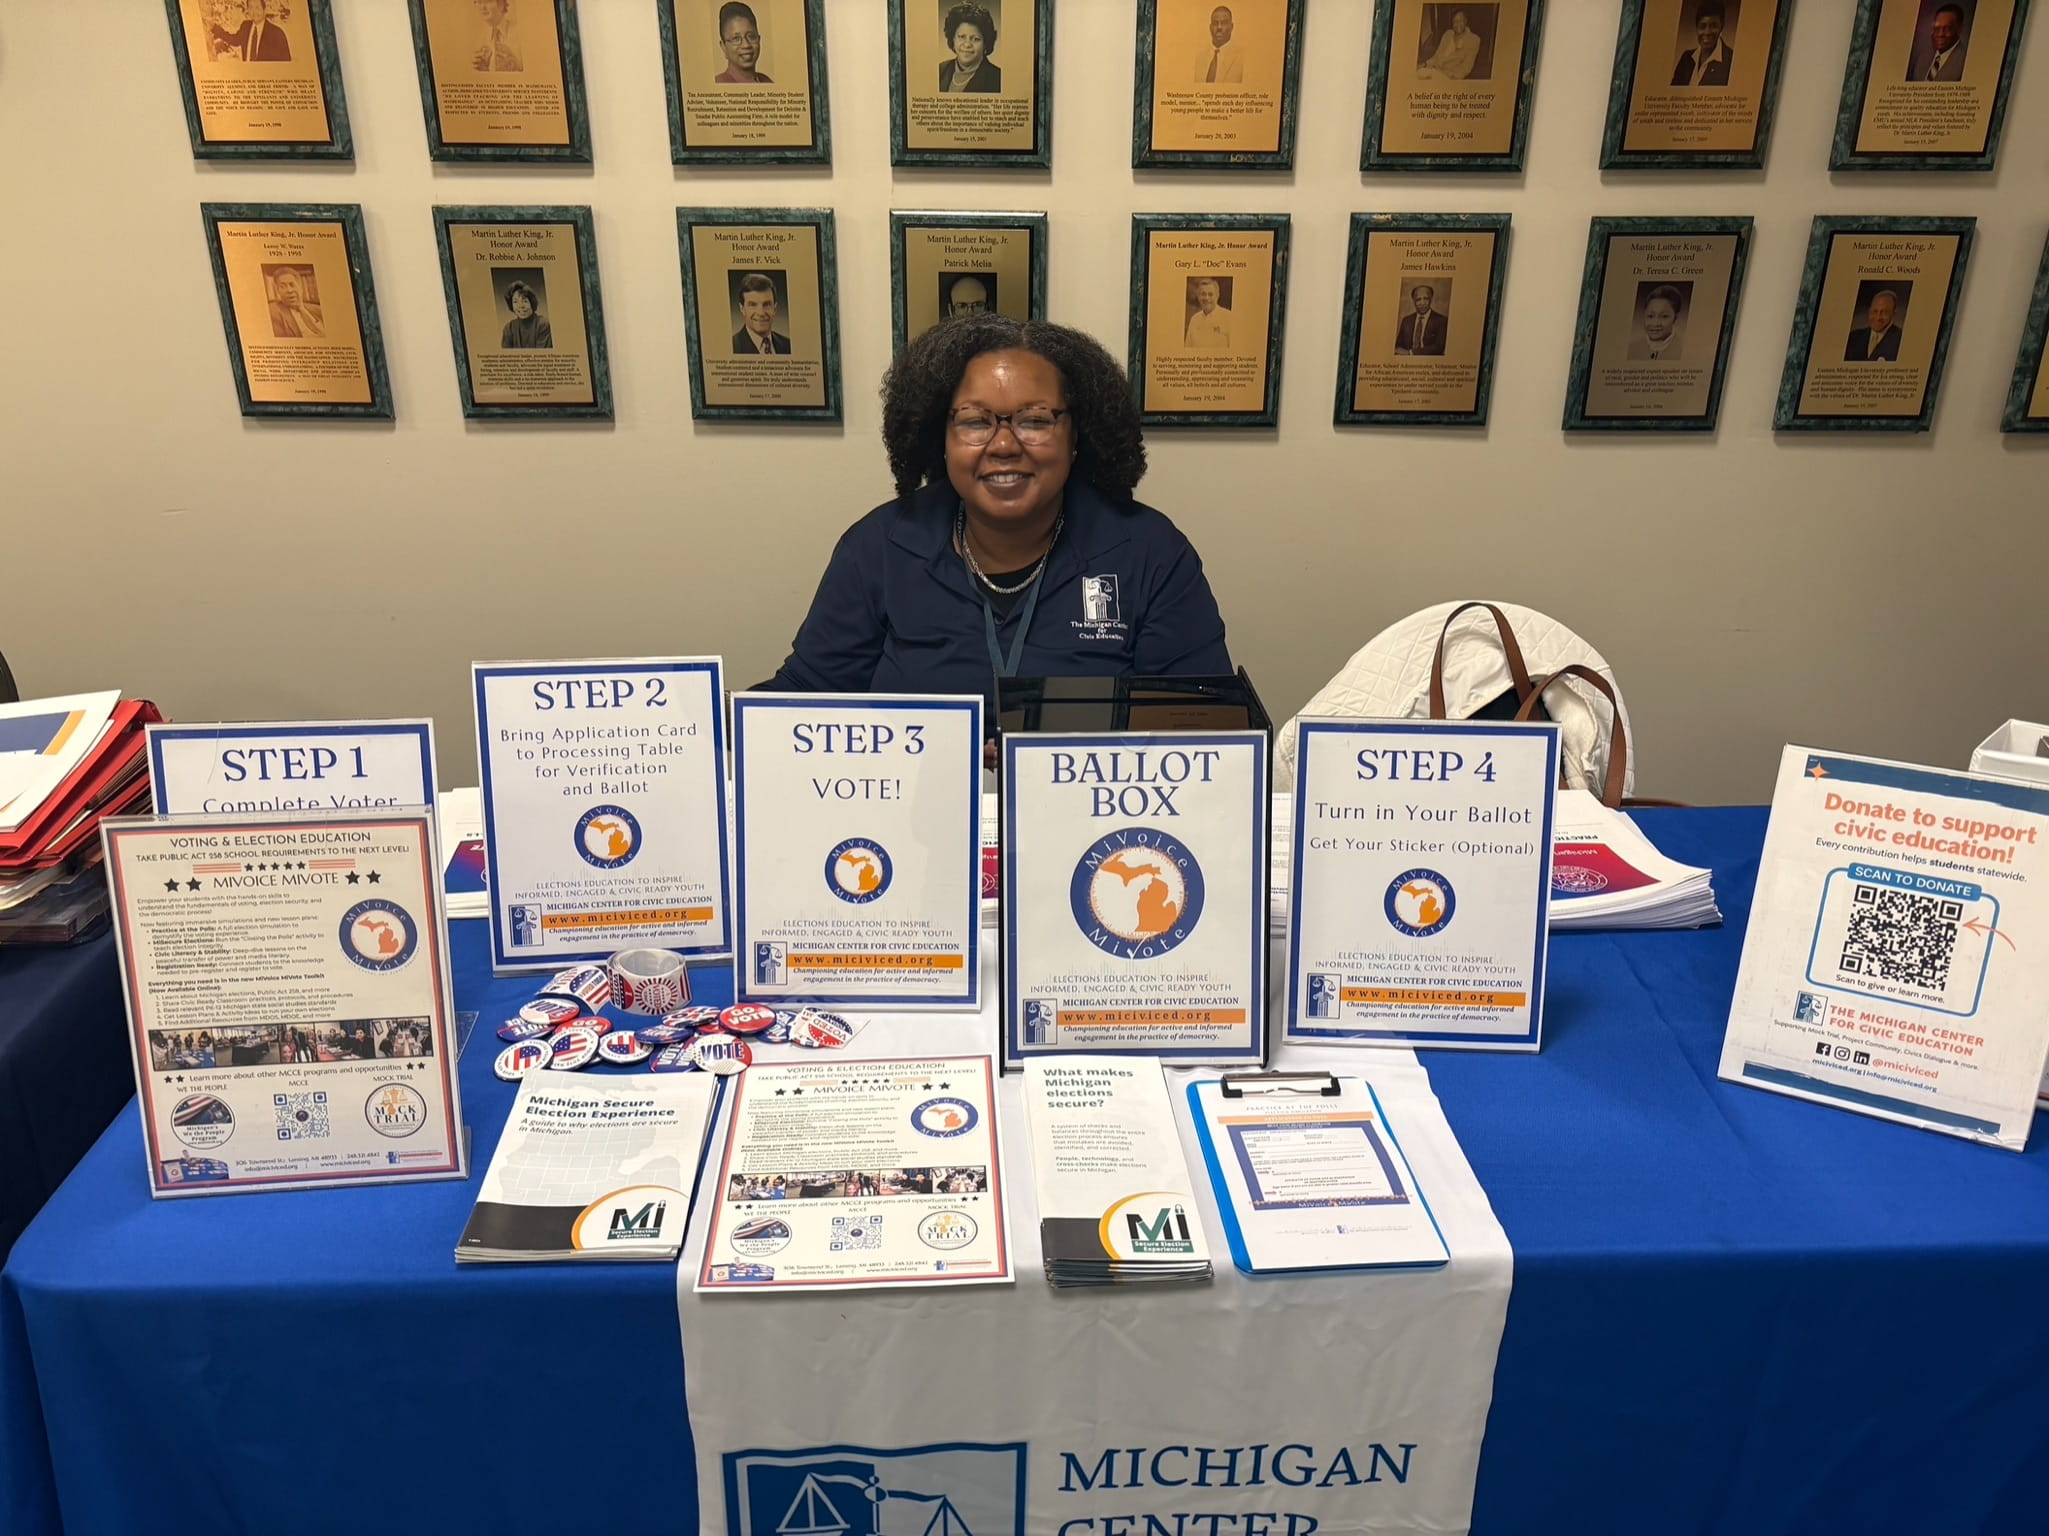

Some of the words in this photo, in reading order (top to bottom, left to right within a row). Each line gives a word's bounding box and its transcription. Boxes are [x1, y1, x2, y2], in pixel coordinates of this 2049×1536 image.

[471, 228, 496, 237] Martin
[497, 229, 521, 238] Luther
[523, 229, 543, 239] King,
[740, 232, 763, 241] Luther
[765, 232, 785, 242] King,
[926, 234, 951, 243] Martin
[953, 234, 976, 243] Luther
[979, 235, 998, 245] King,
[732, 242, 754, 251] Honor
[756, 243, 779, 251] Award
[944, 244, 966, 253] Honor
[968, 245, 992, 254] Award
[1416, 239, 1440, 248] Luther
[1442, 239, 1461, 249] King,
[473, 252, 487, 261] Dr.
[488, 252, 514, 261] Robbie
[764, 255, 781, 264] Vick
[944, 258, 968, 267] Patrick
[971, 259, 992, 268] Melia
[1175, 260, 1191, 269] Gary
[1400, 262, 1422, 270] James
[1424, 262, 1455, 270] Hawkins
[533, 679, 633, 710] STEP
[645, 678, 666, 706] 2
[501, 729, 543, 744] Bring
[552, 725, 648, 743] Application
[657, 723, 696, 736] Card
[793, 723, 893, 753] STEP
[905, 725, 924, 754] 3
[517, 748, 533, 759] to
[542, 745, 629, 759] Processing
[637, 742, 682, 755] Table
[222, 747, 336, 781] STEP
[349, 746, 367, 777] 1
[535, 765, 559, 778] for
[566, 762, 666, 776] Verification
[1051, 750, 1219, 783] BALLOT
[1357, 749, 1462, 781] STEP
[1473, 751, 1496, 782] 4
[563, 782, 592, 795] and
[601, 780, 648, 794] Ballot
[812, 778, 899, 799] VOTE!
[203, 796, 320, 814] Complete
[330, 795, 398, 808] Voter
[1090, 786, 1179, 816] BOX
[1315, 802, 1364, 819] Turn
[1376, 804, 1393, 819] in
[1405, 805, 1457, 821] Your
[1468, 806, 1531, 823] Ballot
[1824, 792, 1906, 821] Donate
[1913, 808, 1936, 826] to
[1942, 816, 2037, 844] support
[169, 836, 217, 847] VOTING
[222, 836, 230, 846] &
[234, 834, 296, 845] ELECTION
[300, 832, 370, 843] EDUCATION
[1310, 837, 1337, 849] Get
[1345, 838, 1382, 850] Your
[1390, 839, 1444, 852] Sticker
[1452, 841, 1533, 856] (Optional)
[1834, 822, 1886, 841] civic
[1892, 830, 2014, 863] education!
[1085, 832, 1188, 870] MiVoice
[1816, 837, 1840, 850] Every
[1842, 844, 1899, 859] contribution
[1901, 852, 1926, 864] helps
[1929, 859, 1974, 872] students
[1977, 867, 2026, 881] statewide.
[213, 874, 276, 888] MIVOICE
[282, 872, 338, 885] MIVOTE
[1855, 866, 1891, 881] SCAN
[1895, 873, 1912, 885] TO
[1916, 877, 1971, 896] DONATE
[1836, 974, 1855, 984] Scan
[1867, 981, 1885, 990] give
[1898, 987, 1919, 998] learn
[1921, 994, 1944, 1003] more.
[728, 1012, 772, 1025] VOTE
[732, 1007, 755, 1016] GO
[1064, 1011, 1212, 1022] www.miciviced.org
[700, 1042, 744, 1061] VOTE
[1086, 1068, 1132, 1076] makes
[1872, 1058, 1938, 1078] @miciviced
[1045, 1078, 1110, 1087] Michigan
[529, 1096, 598, 1109] Michigan
[1048, 1099, 1103, 1107] secure?
[526, 1106, 586, 1117] Election
[591, 1109, 674, 1119] Experience
[1058, 1443, 1417, 1491] MICHIGAN
